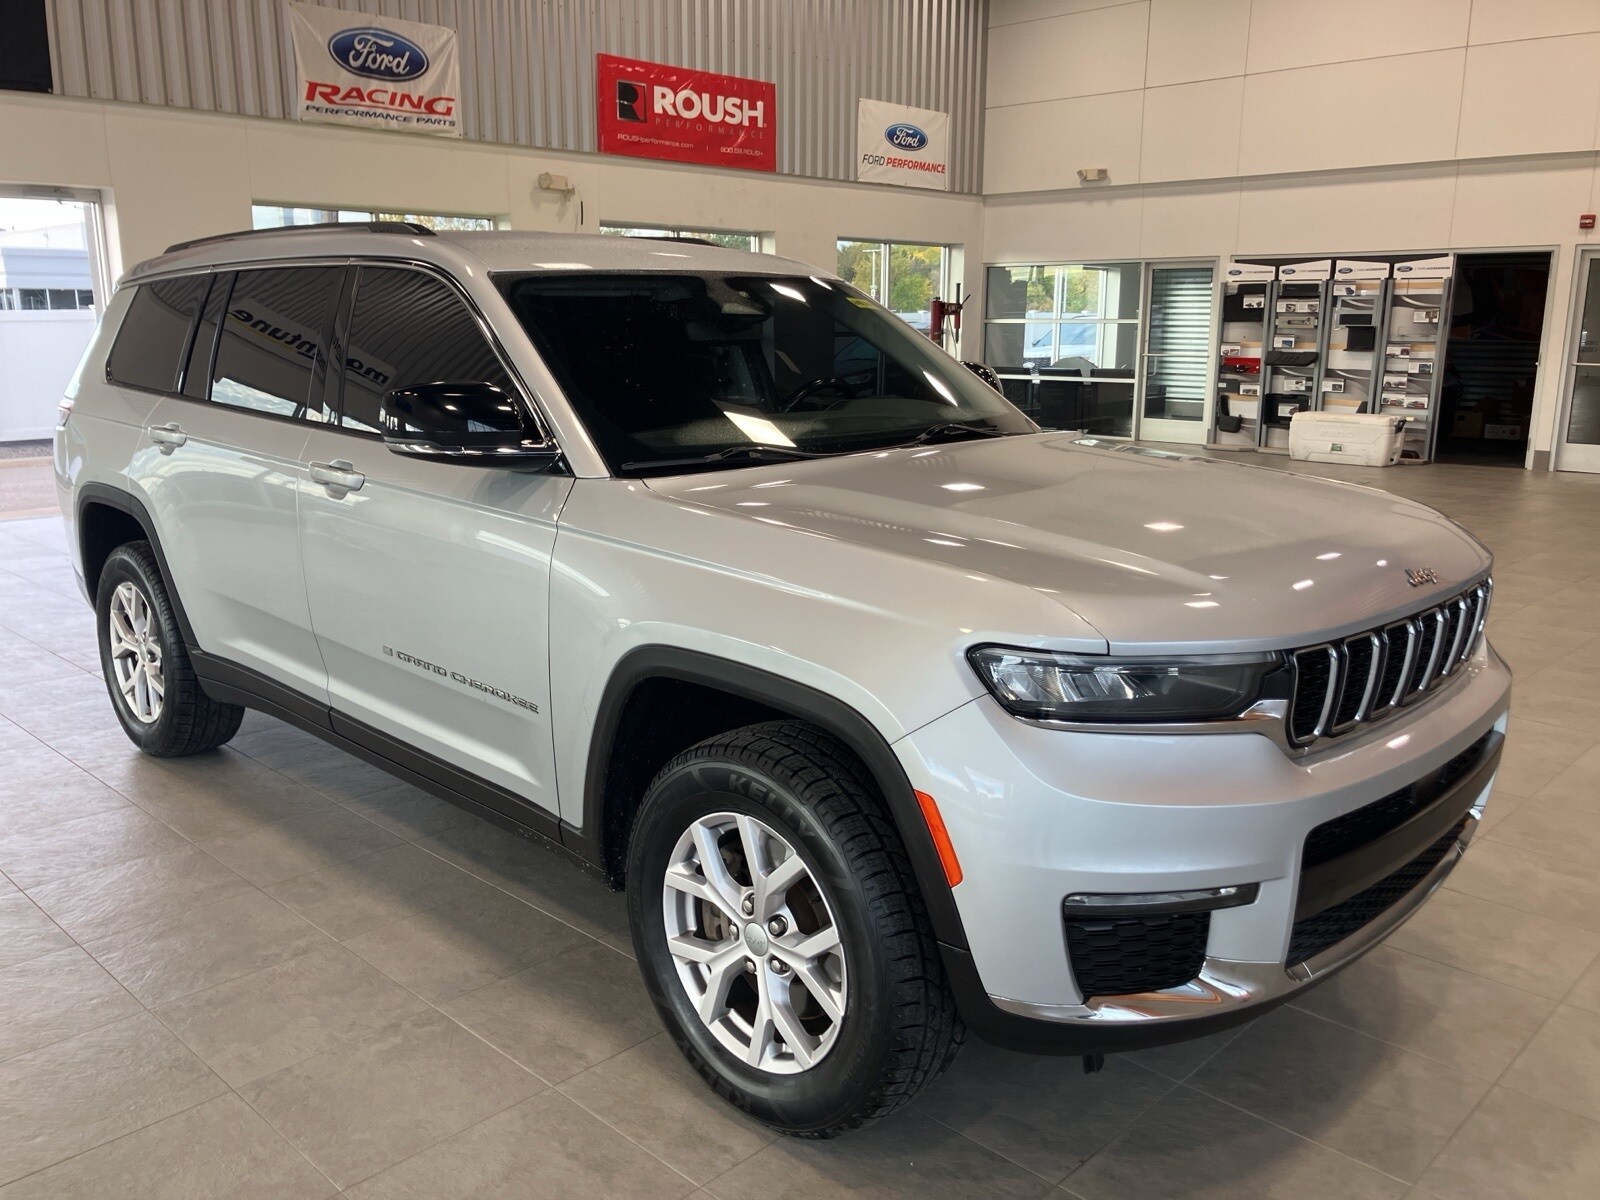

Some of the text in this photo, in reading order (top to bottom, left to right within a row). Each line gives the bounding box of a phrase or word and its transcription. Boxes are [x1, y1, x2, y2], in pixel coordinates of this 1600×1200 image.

[349, 35, 410, 75] Ford
[305, 80, 455, 116] RACING
[305, 105, 456, 127] PERFORMANCE PARTS
[653, 85, 764, 128] ROUSH
[655, 117, 764, 139] PERFORMANCE
[893, 127, 920, 147] Ford
[862, 154, 946, 174] FORD PERFORMANCE
[396, 651, 540, 715] GRAND CHEROKEE
[729, 773, 817, 837] KELLY
